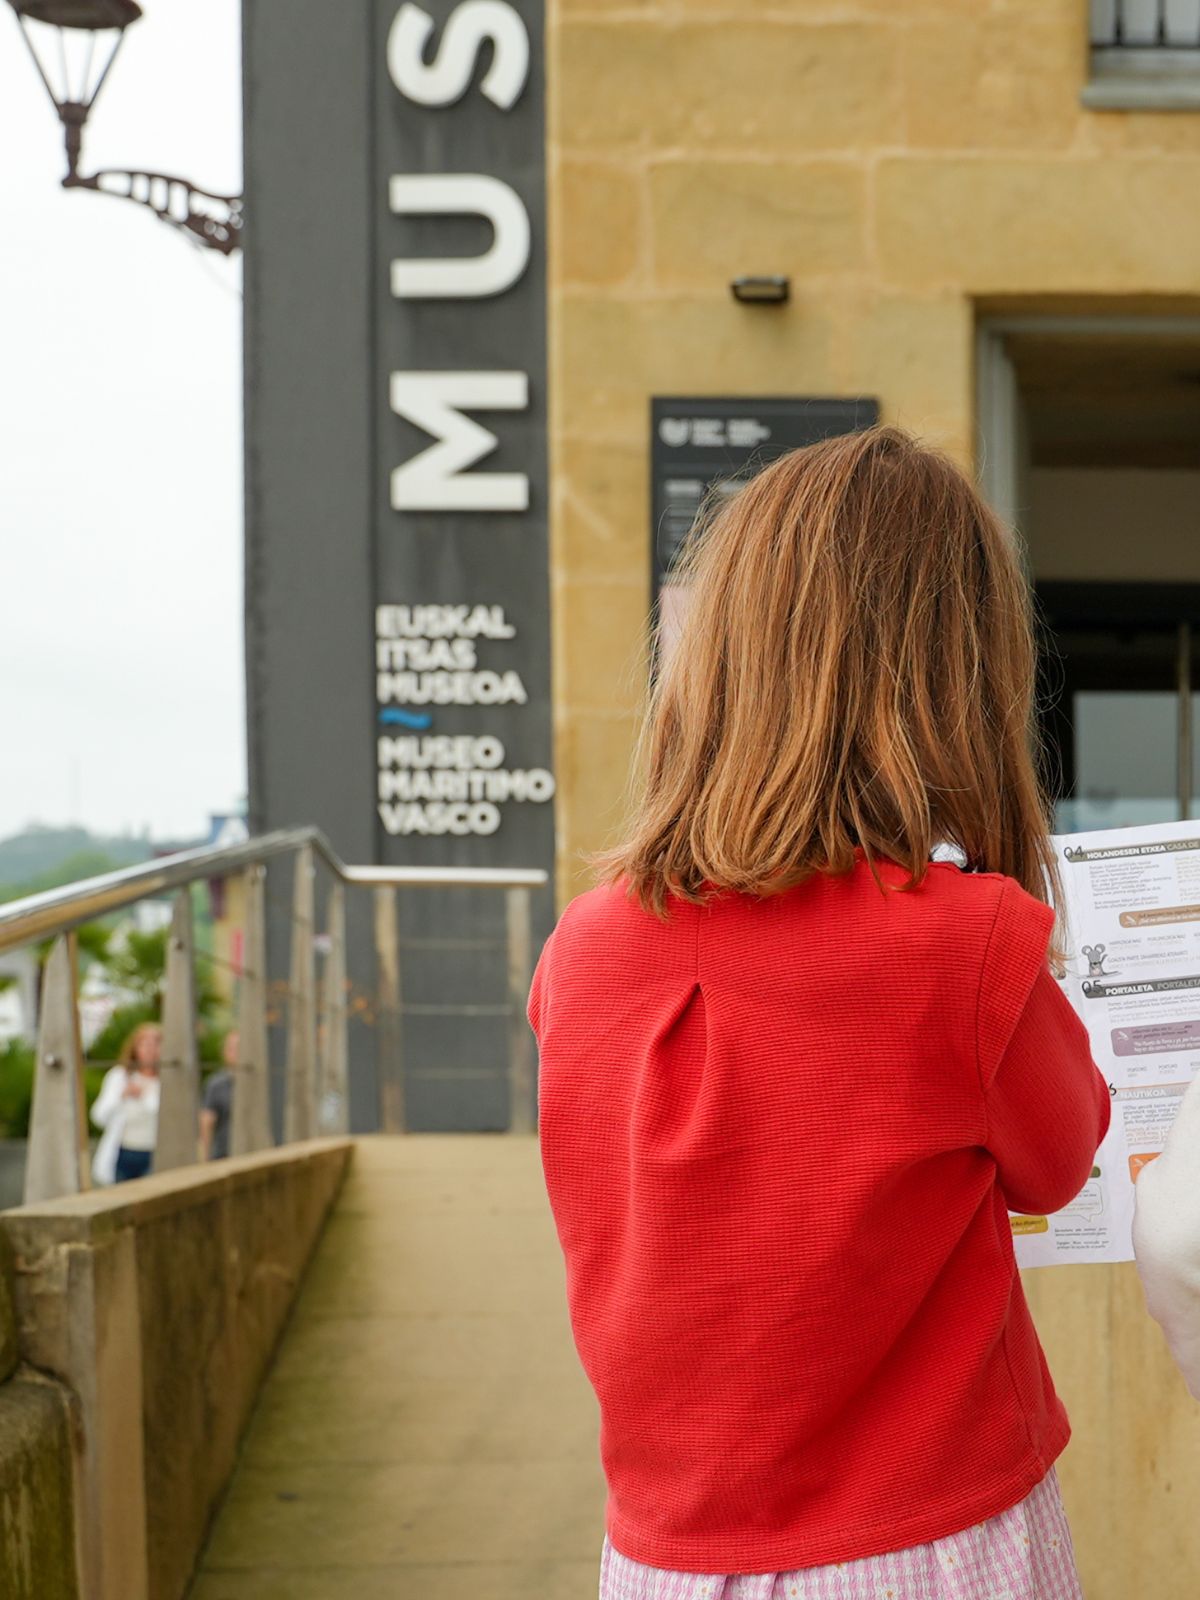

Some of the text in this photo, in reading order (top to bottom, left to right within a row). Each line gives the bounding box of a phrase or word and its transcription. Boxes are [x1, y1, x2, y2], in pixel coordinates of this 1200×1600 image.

[386, 0, 531, 511] MUS
[376, 604, 517, 639] EUSKAL
[376, 638, 478, 671] ITSAS
[377, 670, 528, 704] MUSEOA
[377, 735, 506, 769] MUSEO
[377, 801, 502, 836] VASCO
[1063, 845, 1085, 861] 04
[1087, 847, 1141, 860] HOLANDESEN
[1140, 844, 1167, 856] ETXEA
[1167, 842, 1189, 852] CASA
[1188, 840, 1200, 849] DE
[1105, 983, 1154, 996] PORTALETA
